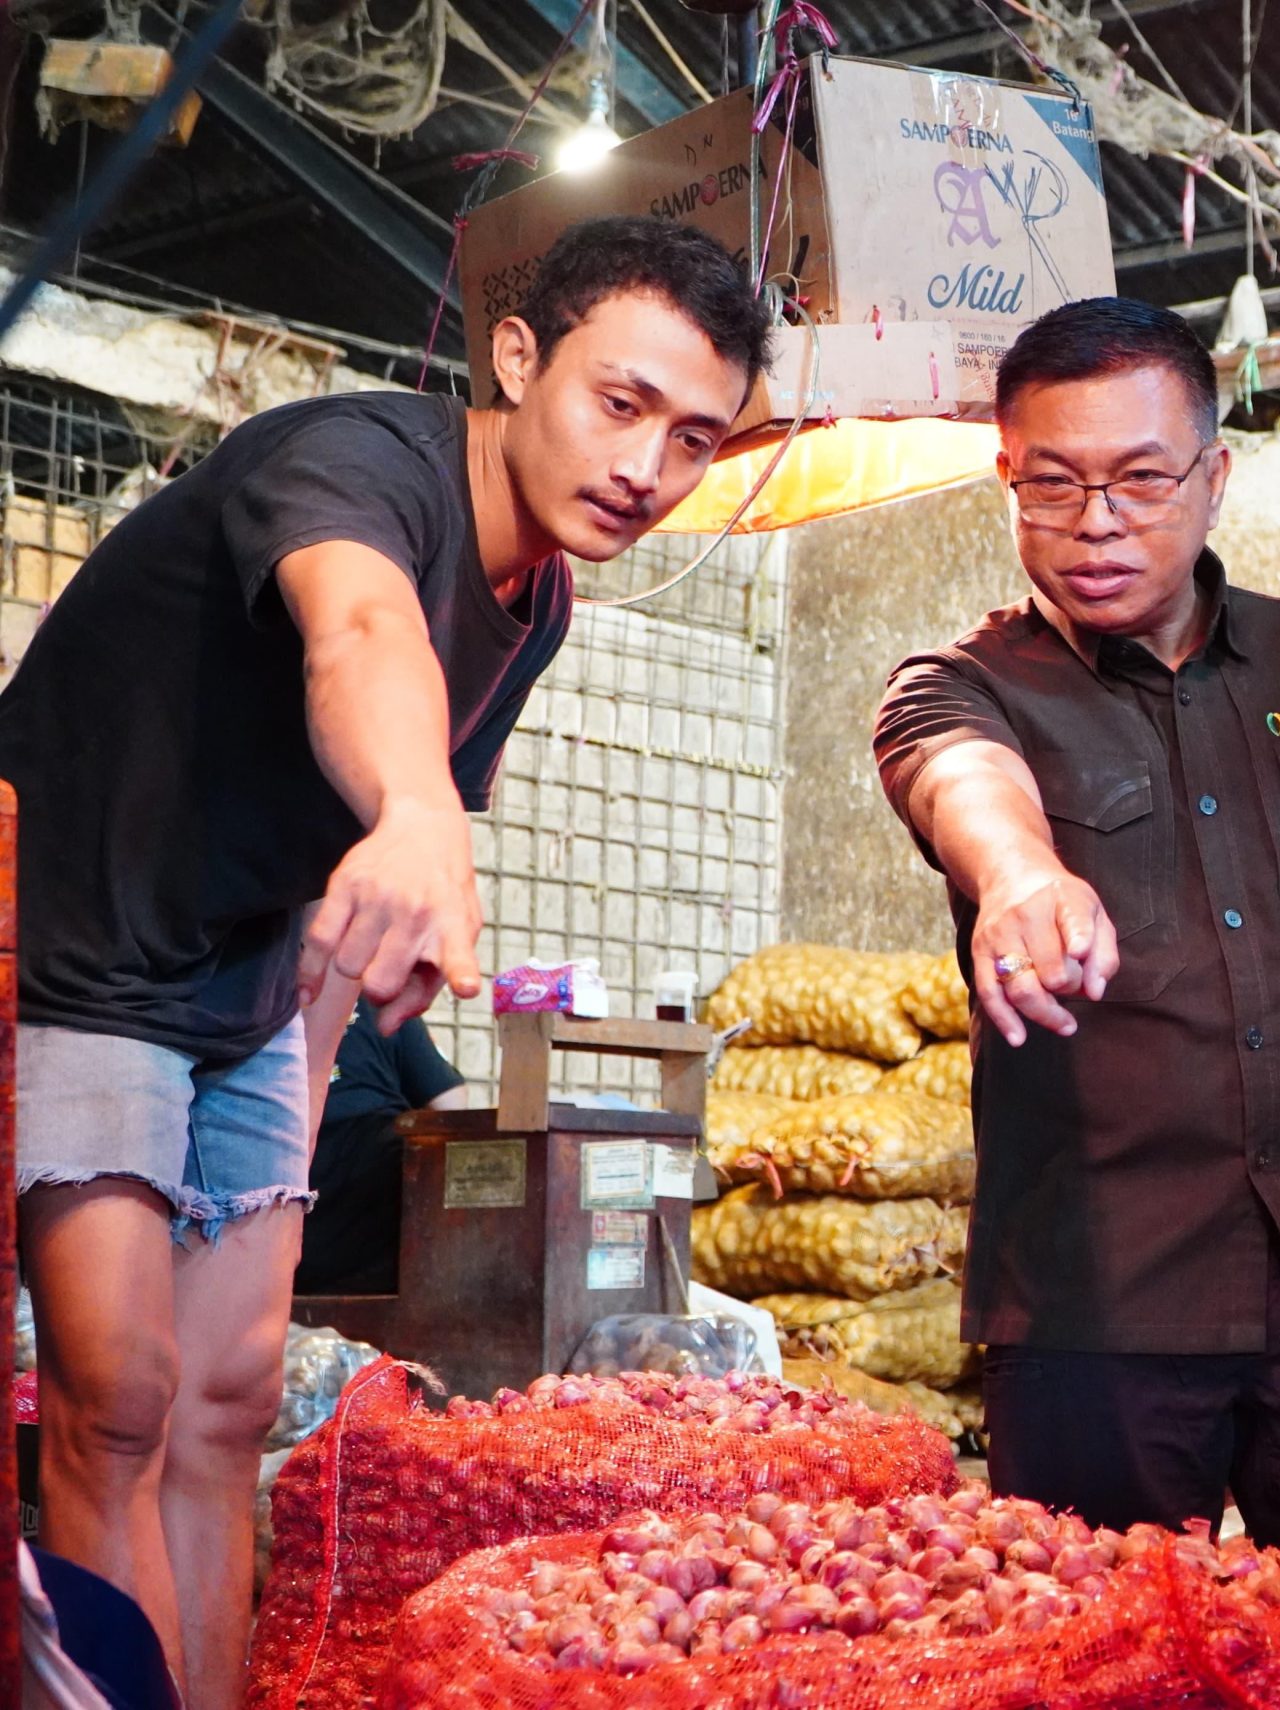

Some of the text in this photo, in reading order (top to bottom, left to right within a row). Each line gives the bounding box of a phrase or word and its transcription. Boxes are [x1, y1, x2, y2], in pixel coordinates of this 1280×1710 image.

[900, 117, 1014, 154] SAMPOERNA
[1052, 120, 1095, 144] Batang
[927, 263, 1025, 315] Mild
[957, 342, 1009, 358] SAMPOER
[954, 356, 980, 369] BAYA
